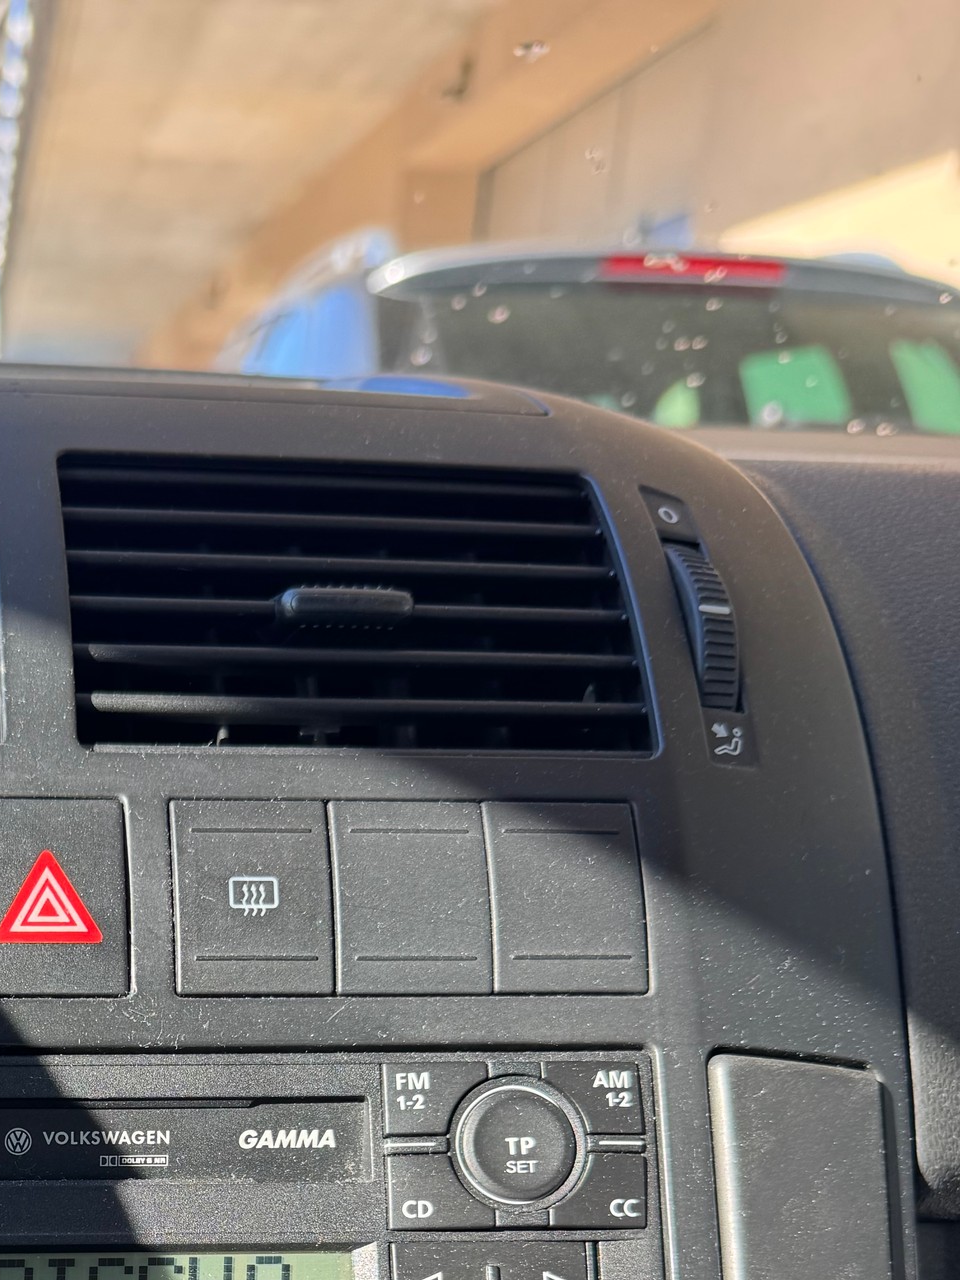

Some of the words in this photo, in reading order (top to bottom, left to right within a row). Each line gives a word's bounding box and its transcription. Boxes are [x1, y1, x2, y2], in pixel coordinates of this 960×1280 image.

[395, 1072, 430, 1091] FM
[593, 1070, 632, 1089] AM
[396, 1094, 425, 1111] 1-2
[605, 1091, 633, 1109] 1-2
[42, 1130, 170, 1145] VOLKSWAGEN
[238, 1130, 336, 1149] GAMMA
[504, 1136, 535, 1155] TP
[505, 1160, 538, 1174] SET
[402, 1200, 434, 1219] CD
[609, 1198, 640, 1217] CC
